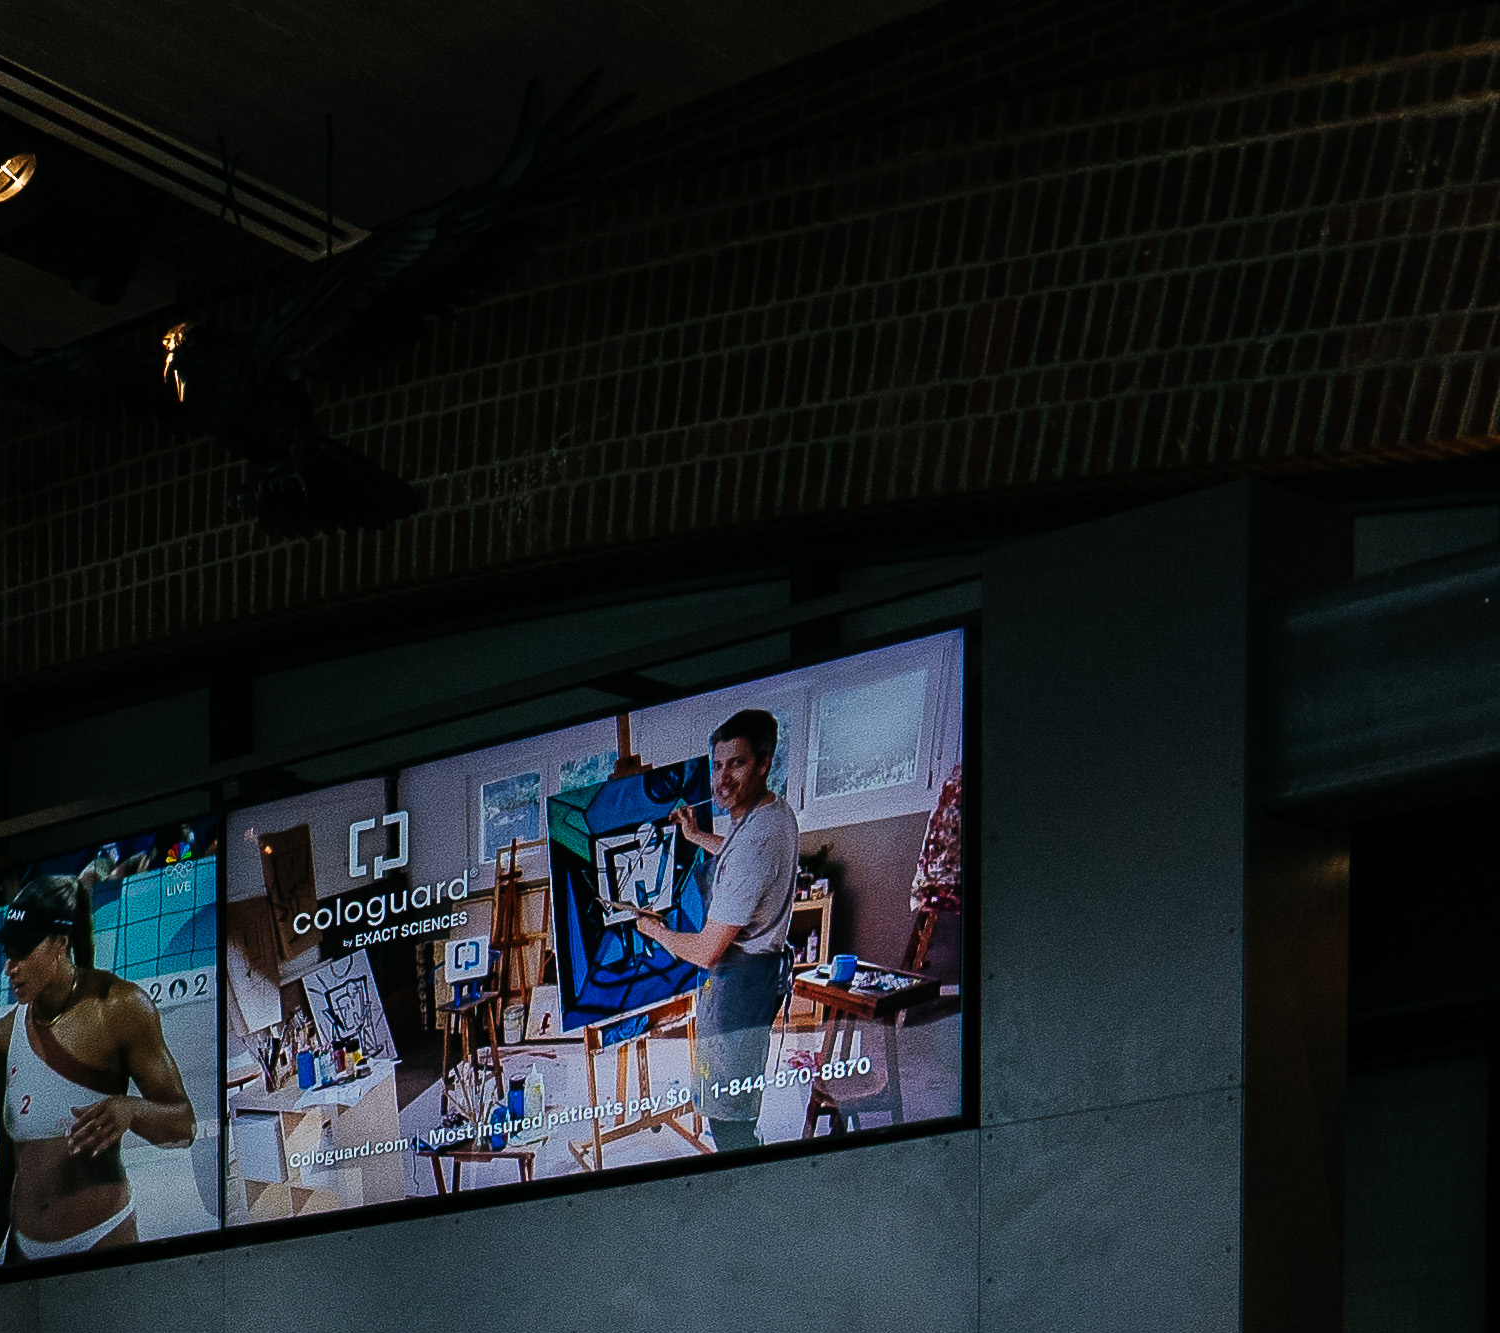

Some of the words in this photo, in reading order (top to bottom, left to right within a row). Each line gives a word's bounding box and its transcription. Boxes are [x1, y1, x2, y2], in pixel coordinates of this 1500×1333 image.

[166, 882, 191, 897] LIVE
[293, 869, 468, 935] cologuard
[355, 925, 399, 947] EXACT
[401, 911, 469, 938] SCIENCES
[19, 1094, 32, 1115] 2
[288, 1136, 409, 1168] Cologuard.com
[429, 1124, 475, 1146] Most
[477, 1111, 543, 1138] insured
[548, 1099, 624, 1132] patients
[628, 1094, 661, 1117] pay
[666, 1087, 691, 1107] $0
[710, 1056, 871, 1100] 1-844-870-8870
